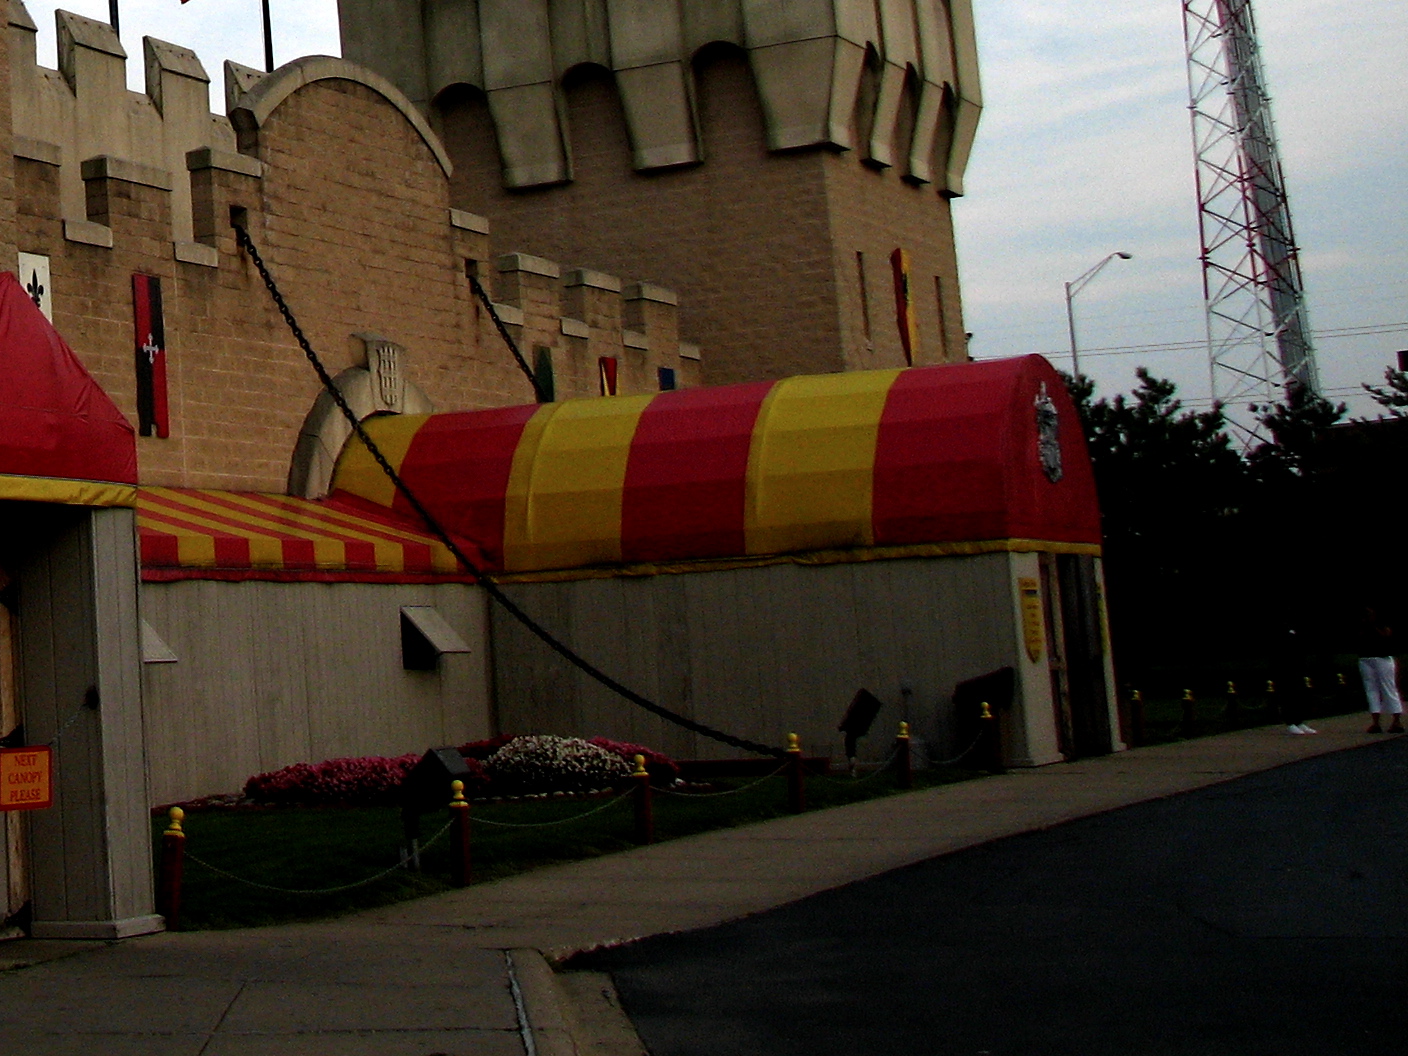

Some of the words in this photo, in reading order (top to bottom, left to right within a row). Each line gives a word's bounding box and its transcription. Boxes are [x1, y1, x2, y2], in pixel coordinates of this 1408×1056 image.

[14, 754, 38, 766] NEXT
[7, 771, 43, 785] CANOPY
[10, 788, 41, 802] PLEASE
